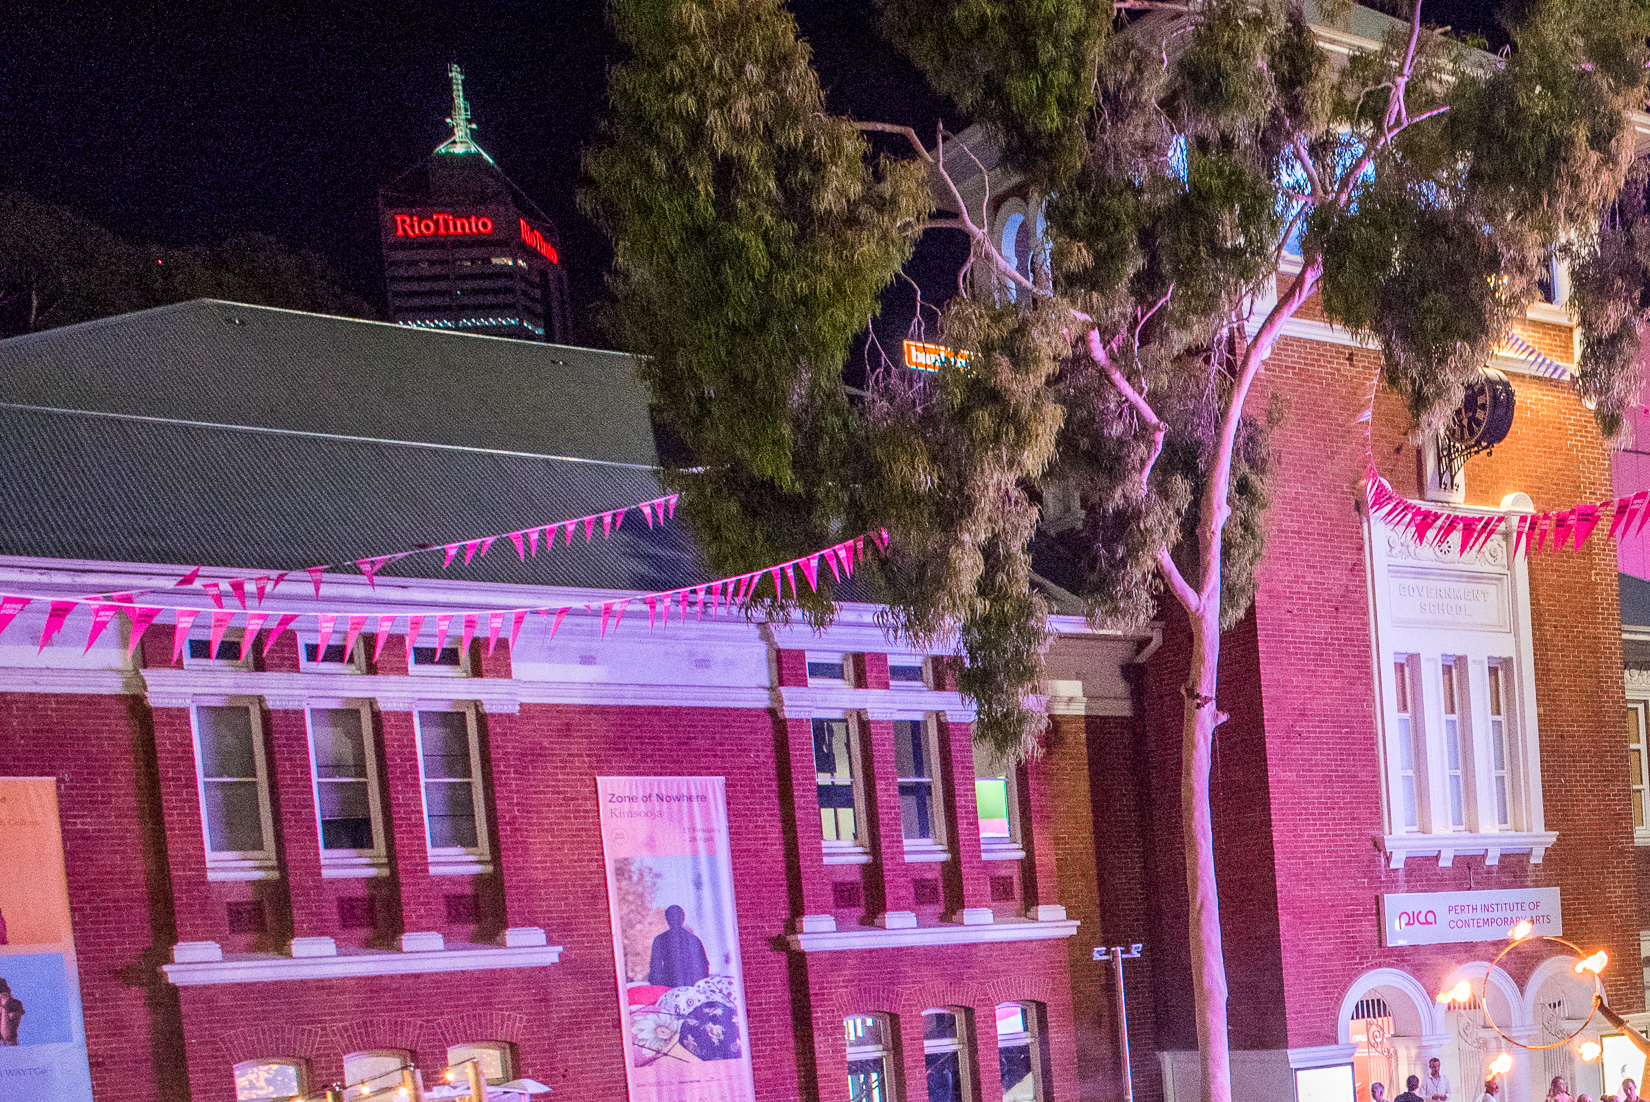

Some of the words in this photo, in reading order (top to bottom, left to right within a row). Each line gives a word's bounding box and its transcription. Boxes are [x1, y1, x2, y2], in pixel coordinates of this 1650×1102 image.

[395, 213, 493, 237] RioTinto
[519, 217, 559, 265] RioTinto
[1398, 583, 1489, 602] GOVERNMENT
[1420, 602, 1472, 616] SCHOOL
[608, 793, 638, 804] Zone
[641, 793, 653, 803] of
[655, 793, 707, 803] Nowhere
[610, 808, 663, 820] Kimsooja
[1448, 904, 1478, 915] PERTH
[1481, 902, 1526, 913] INSTITUTE
[1528, 901, 1541, 911] OF
[1530, 914, 1551, 925] ARTS
